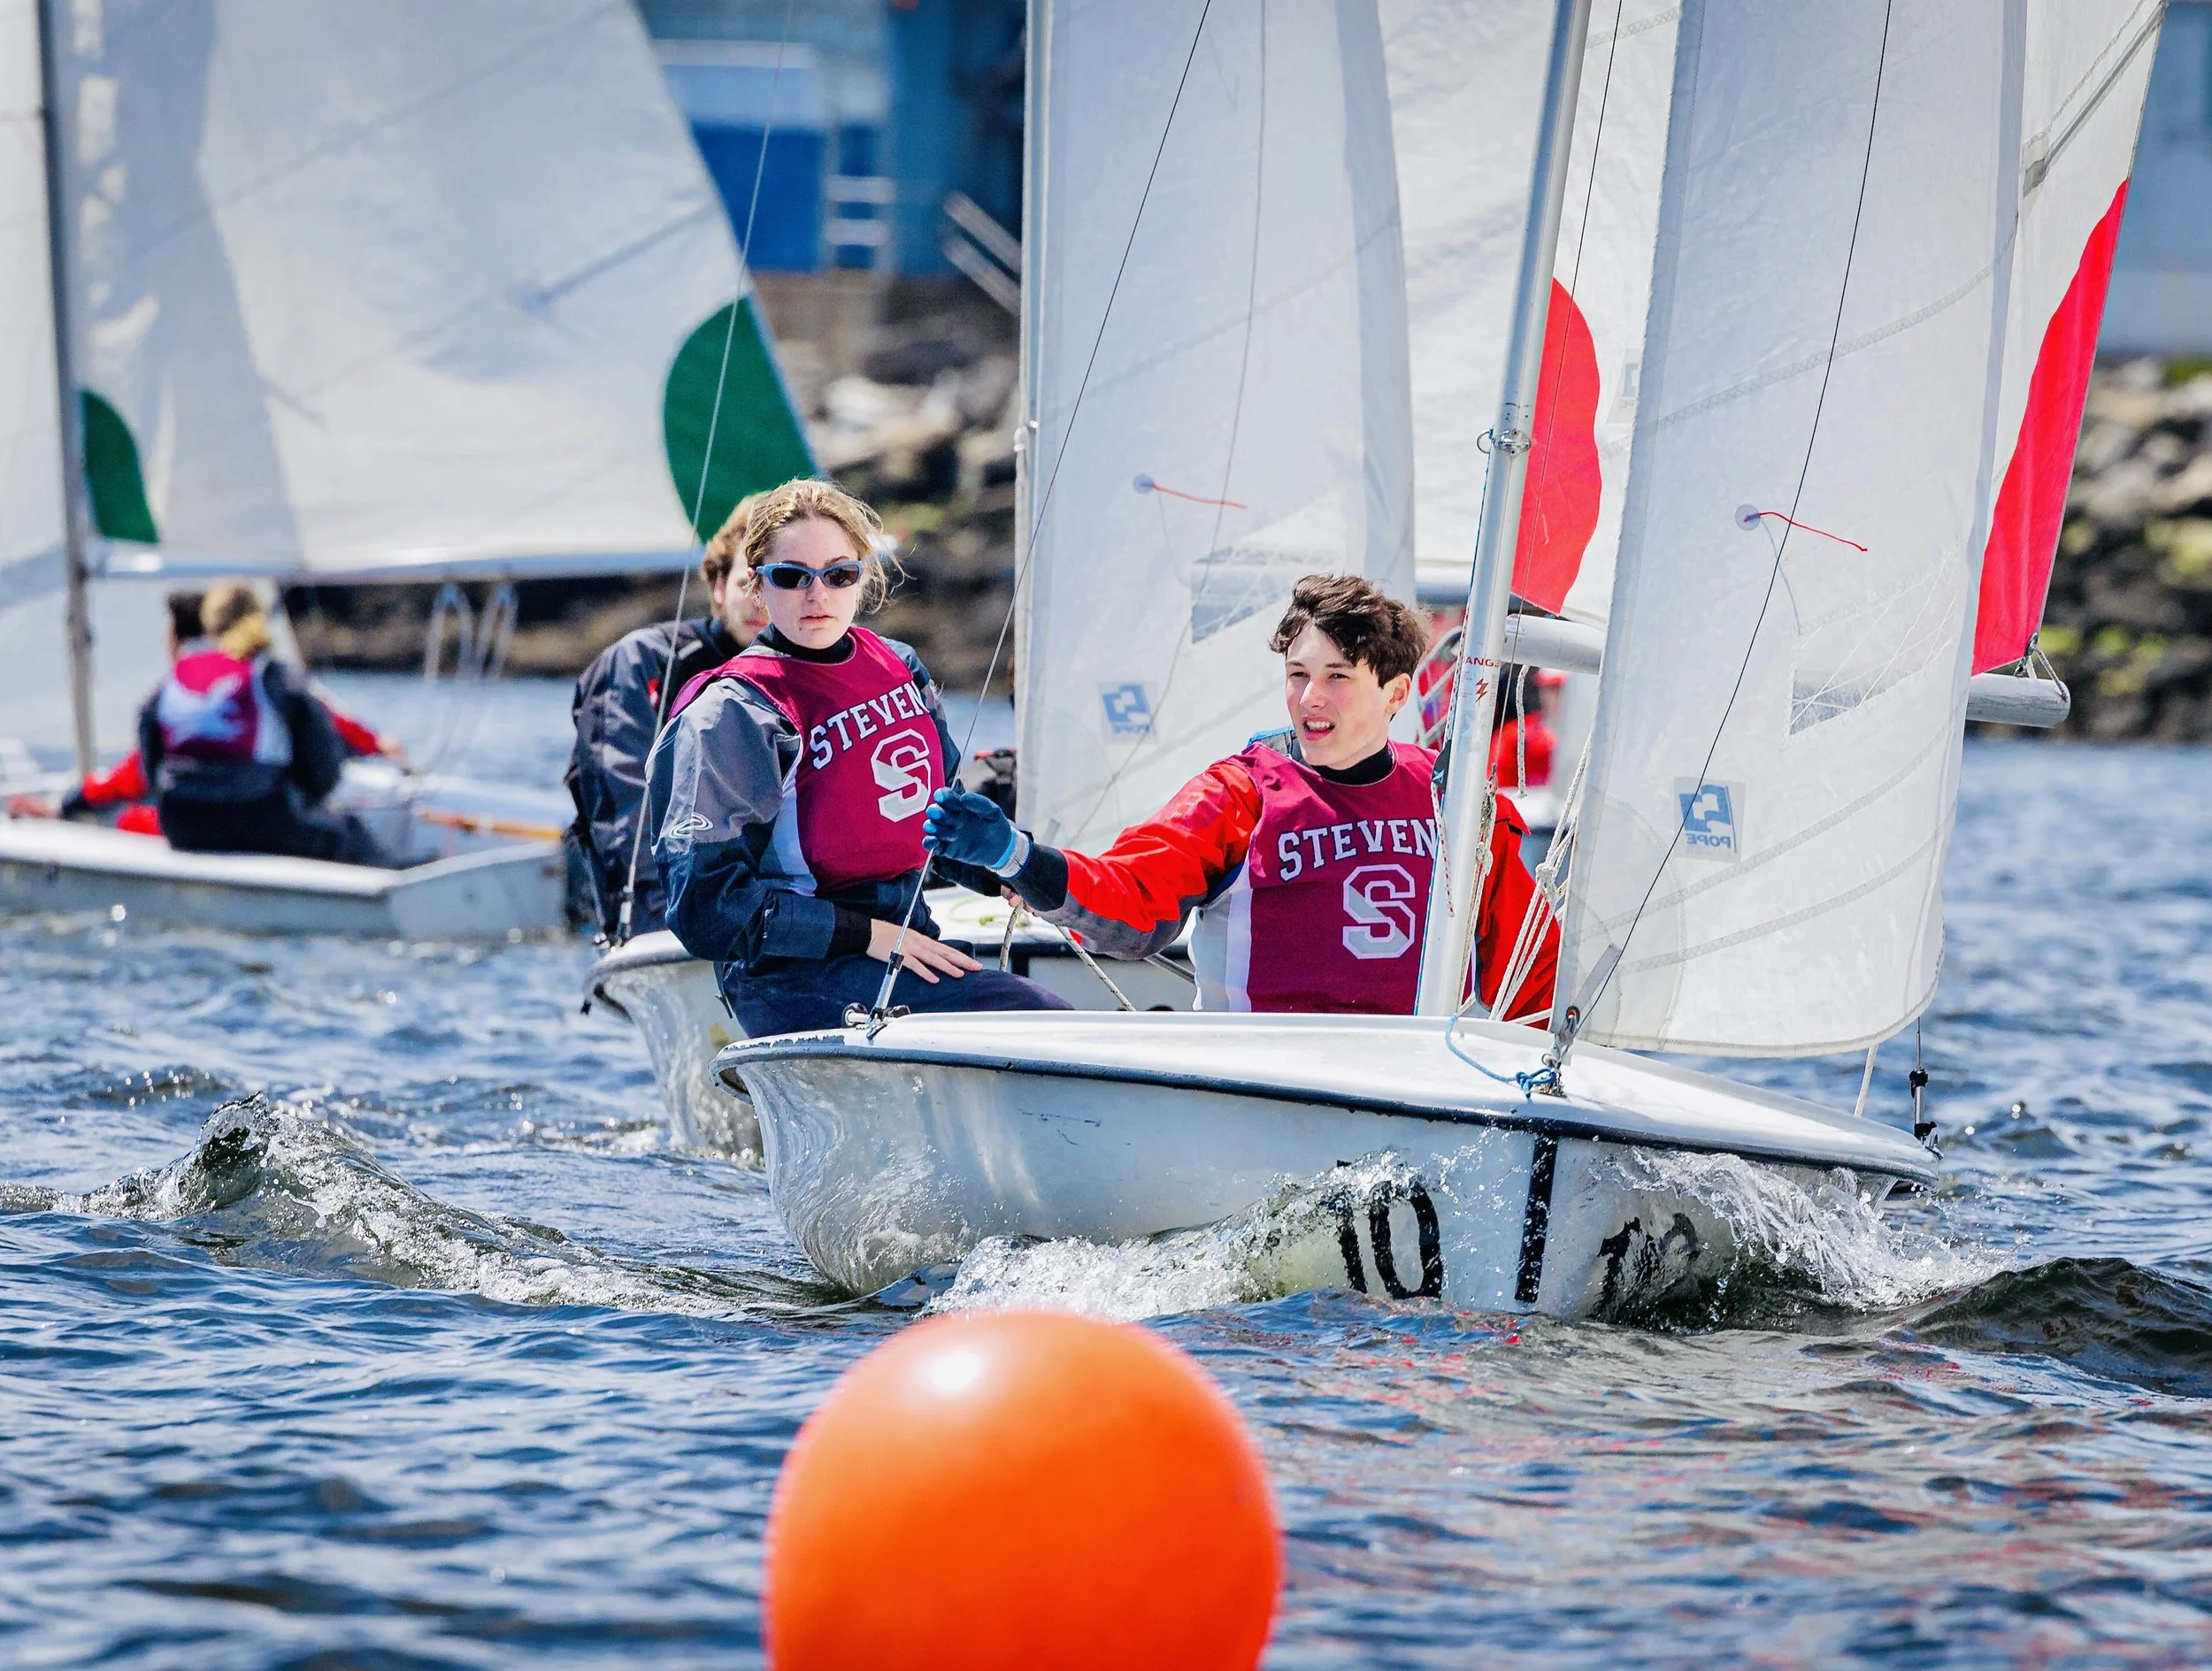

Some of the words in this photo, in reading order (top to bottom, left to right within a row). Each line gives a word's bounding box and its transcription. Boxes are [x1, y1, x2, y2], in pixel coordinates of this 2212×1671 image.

[810, 680, 929, 770] STEVEN
[871, 728, 931, 823] S
[1278, 818, 1437, 882] STEVEN
[1342, 863, 1416, 960] S
